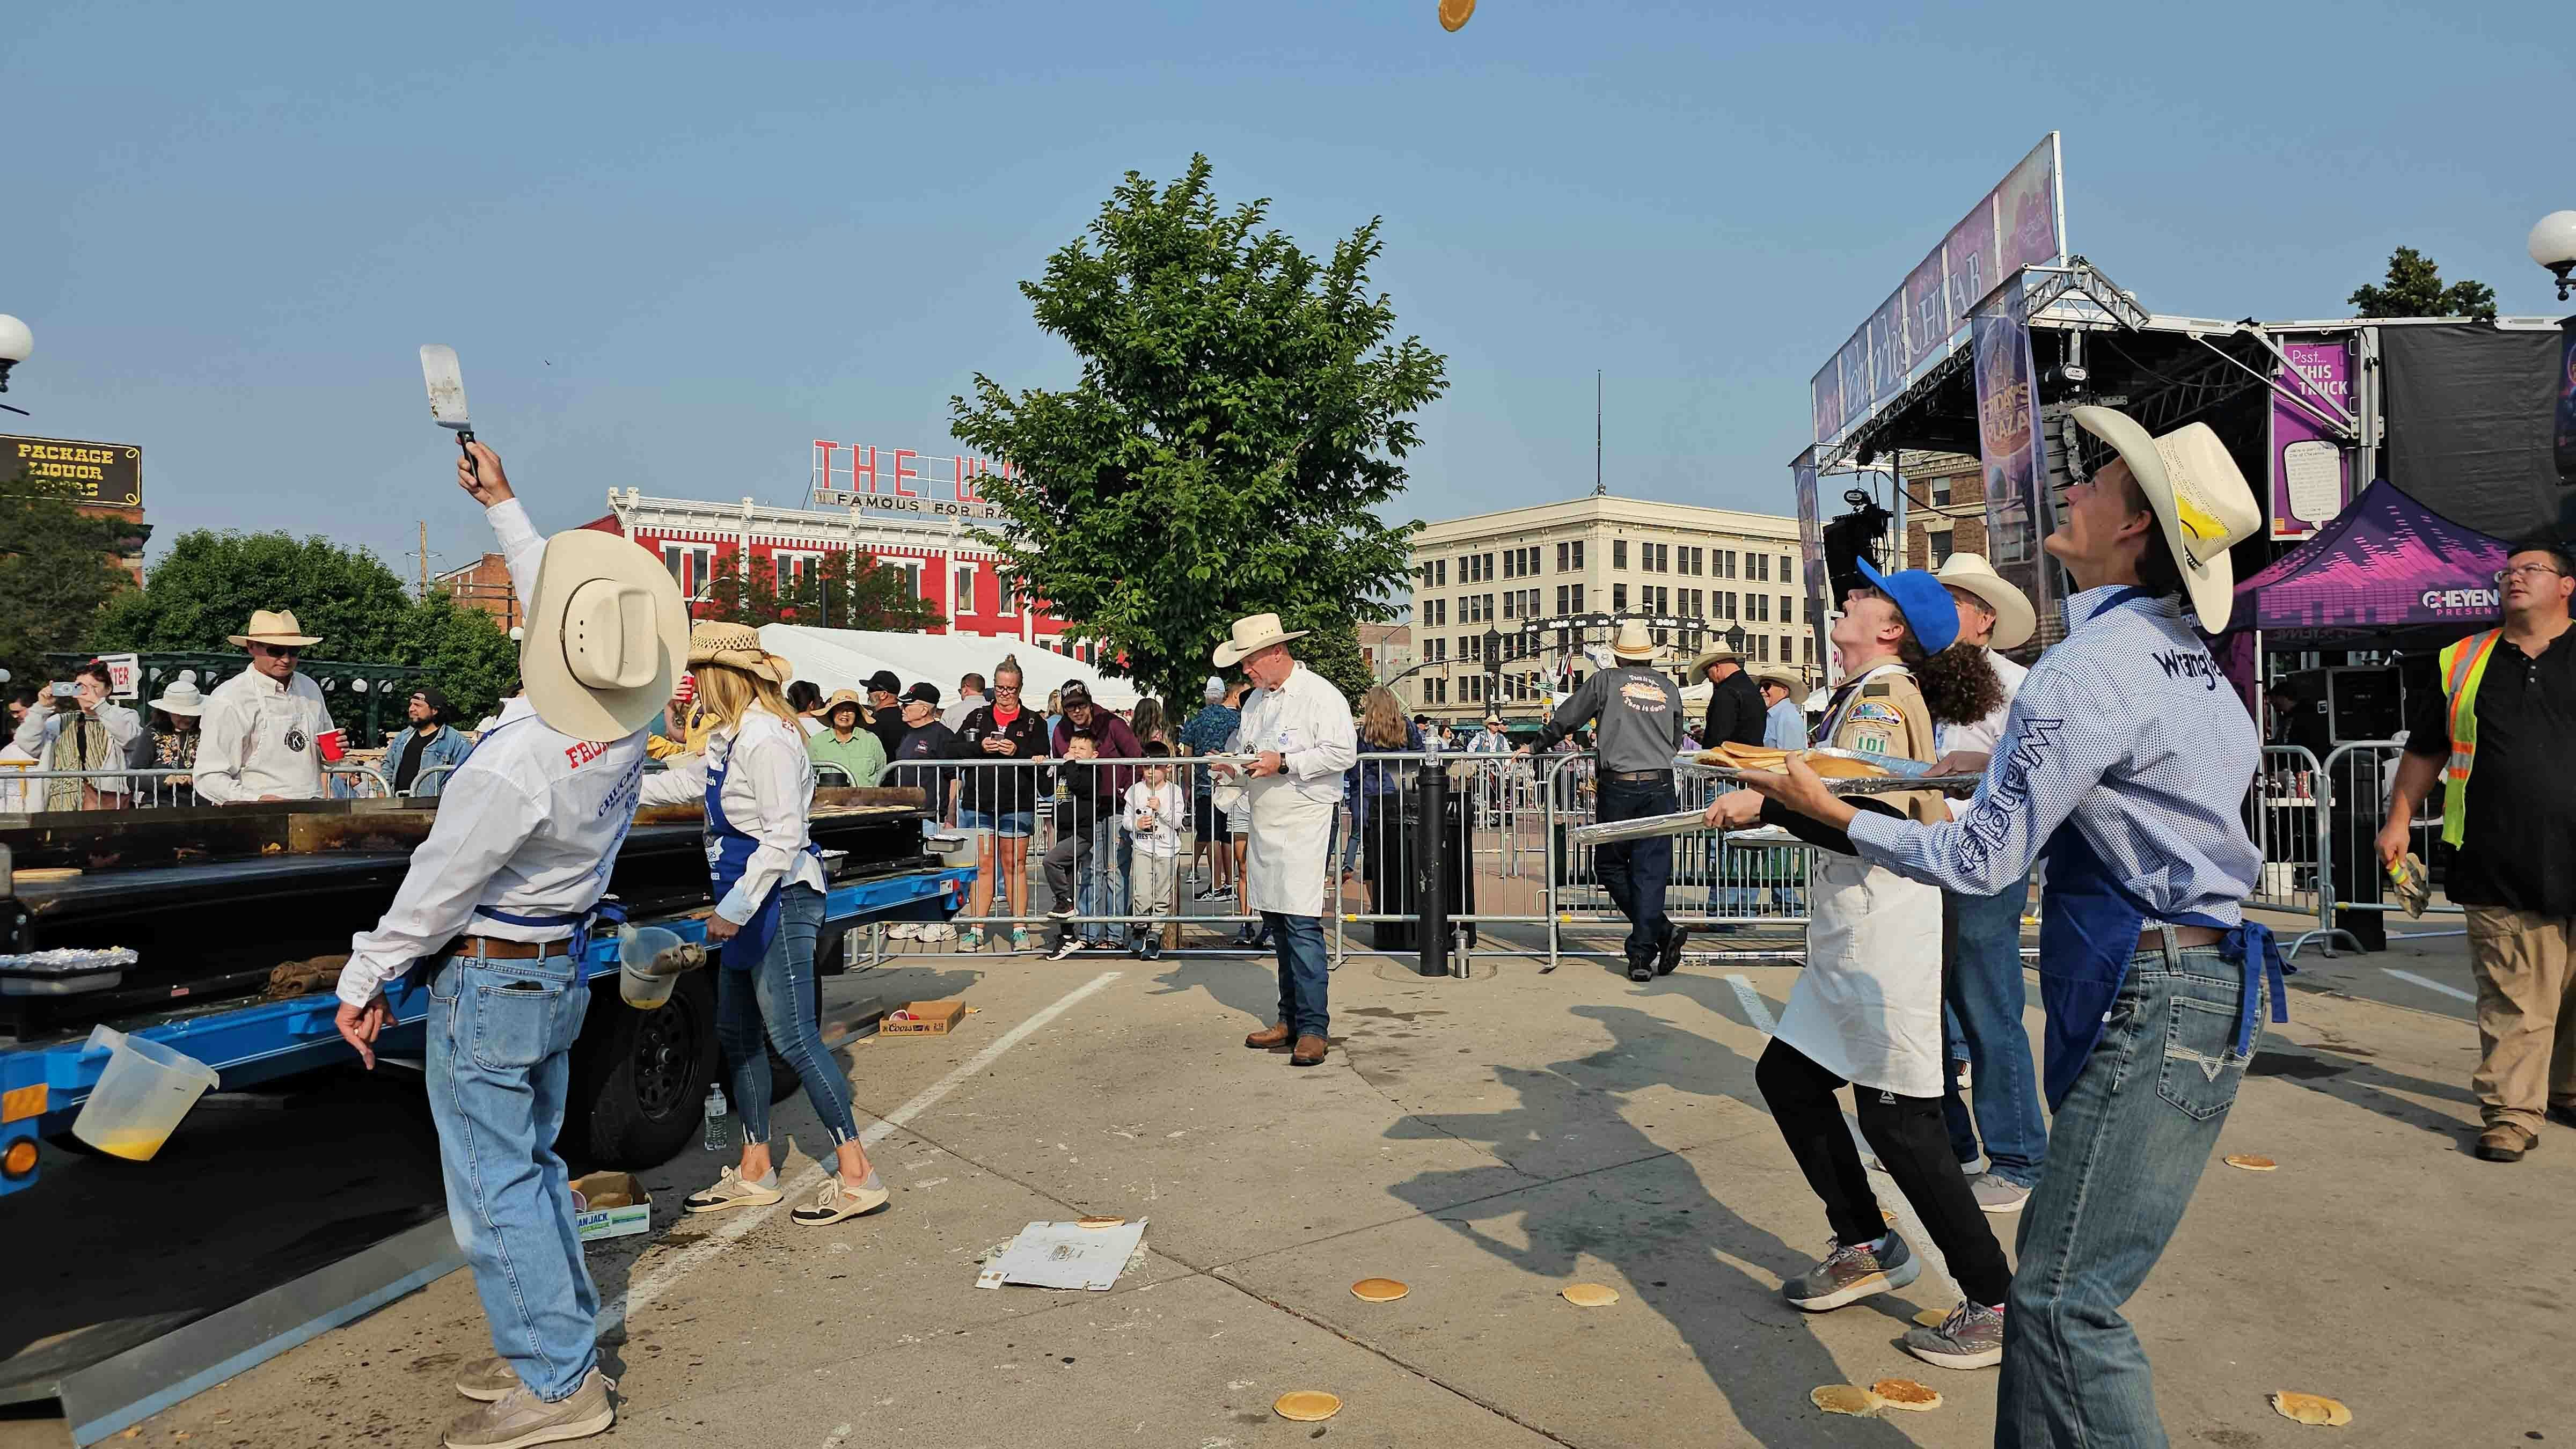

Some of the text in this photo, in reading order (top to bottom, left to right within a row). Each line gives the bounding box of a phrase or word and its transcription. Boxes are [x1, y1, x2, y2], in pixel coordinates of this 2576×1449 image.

[2293, 350, 2326, 363] Psst...
[2297, 365, 2332, 378] THIS
[18, 444, 113, 464] PACKAGE
[29, 462, 104, 480] LIQUOR
[814, 440, 917, 497] THE
[837, 494, 919, 511] FAMOUS
[935, 503, 970, 516] FOR
[1956, 719, 2063, 874] Wrangler
[889, 1023, 912, 1031] Coors
[589, 1212, 608, 1225] JACK
